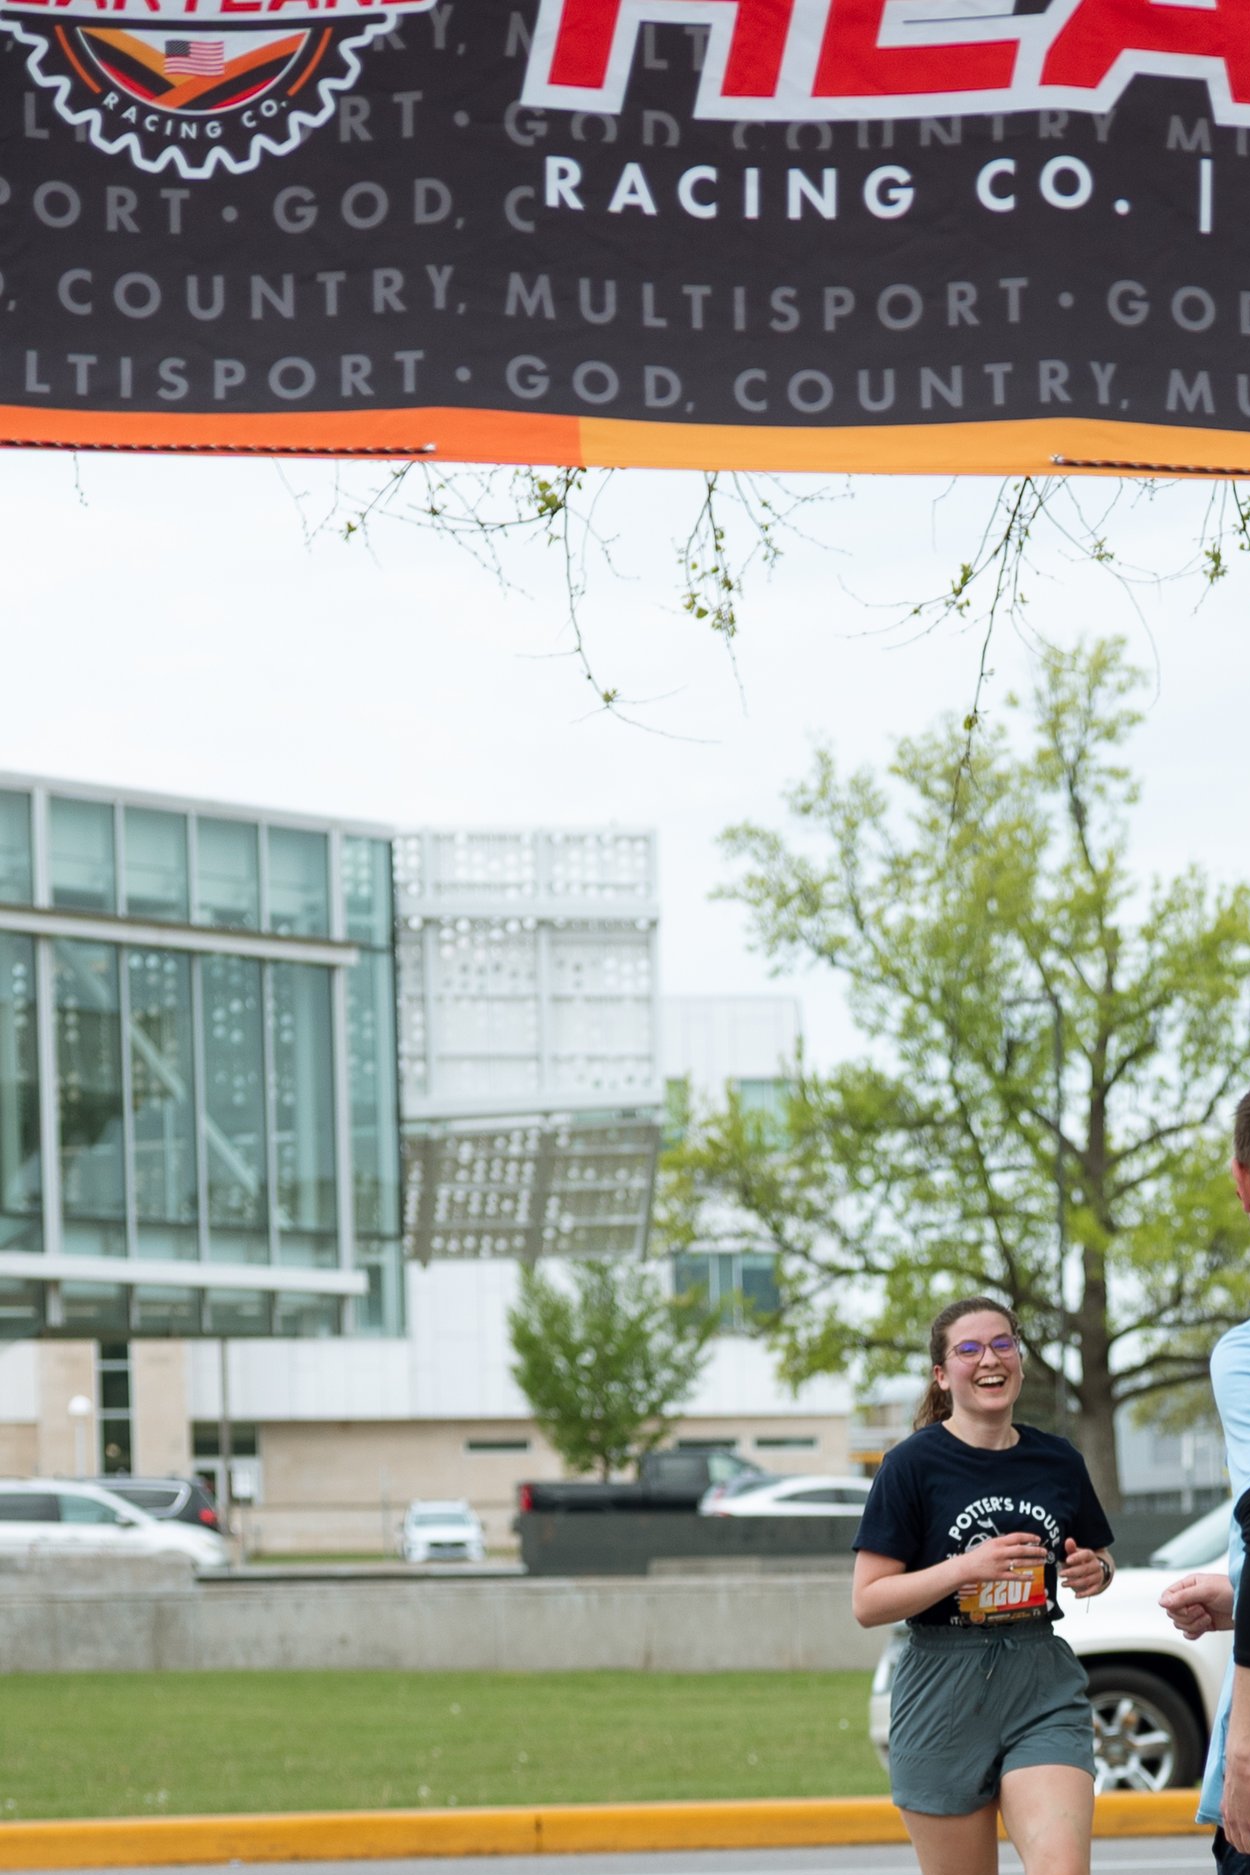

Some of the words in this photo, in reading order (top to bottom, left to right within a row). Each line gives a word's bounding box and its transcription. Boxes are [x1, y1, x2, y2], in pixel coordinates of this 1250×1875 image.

[102, 91, 223, 139] RACING
[243, 99, 288, 128] CO.
[273, 176, 465, 234] GOD,
[545, 155, 914, 219] RACING
[976, 155, 1131, 215] CO.
[58, 265, 467, 320] COUNTRY,
[504, 272, 1028, 332] MULTISPORT
[505, 354, 695, 413] GOD,
[733, 359, 1130, 413] COUNTRY,
[948, 1496, 1015, 1541] POTTER'S
[1018, 1500, 1062, 1548] HOUSE
